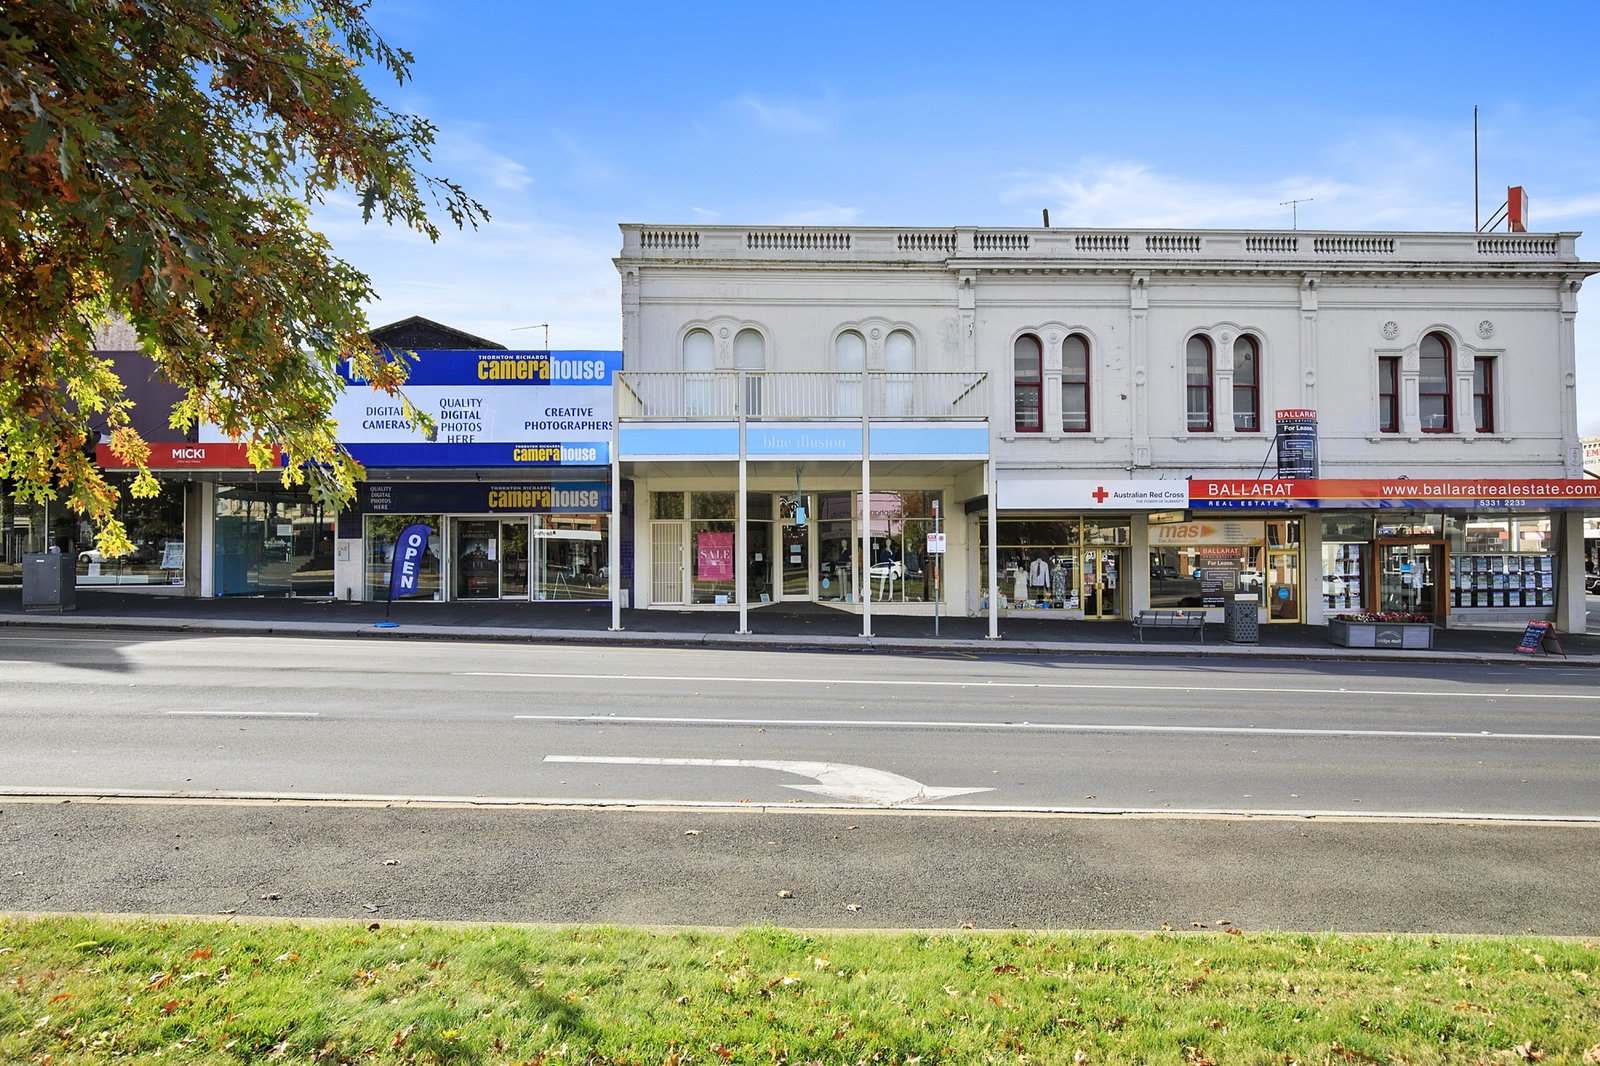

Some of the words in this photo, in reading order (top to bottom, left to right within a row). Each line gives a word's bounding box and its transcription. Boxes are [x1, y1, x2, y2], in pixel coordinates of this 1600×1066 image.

[439, 398, 483, 409] QUALITY
[440, 410, 481, 420] DIGITAL
[544, 407, 594, 417] CREATIVE
[362, 420, 411, 430] CAMERAS
[441, 422, 482, 432] PHOTOS
[524, 420, 613, 431] PHOTOGRAPHERS
[447, 434, 475, 443] HERE
[763, 435, 792, 448] blue
[796, 435, 846, 448] illusion
[171, 449, 206, 459] MICKI
[1208, 483, 1294, 496] BALLARAT
[1158, 525, 1199, 538] mas
[700, 549, 731, 559] SALE
[401, 534, 422, 589] OPEN
